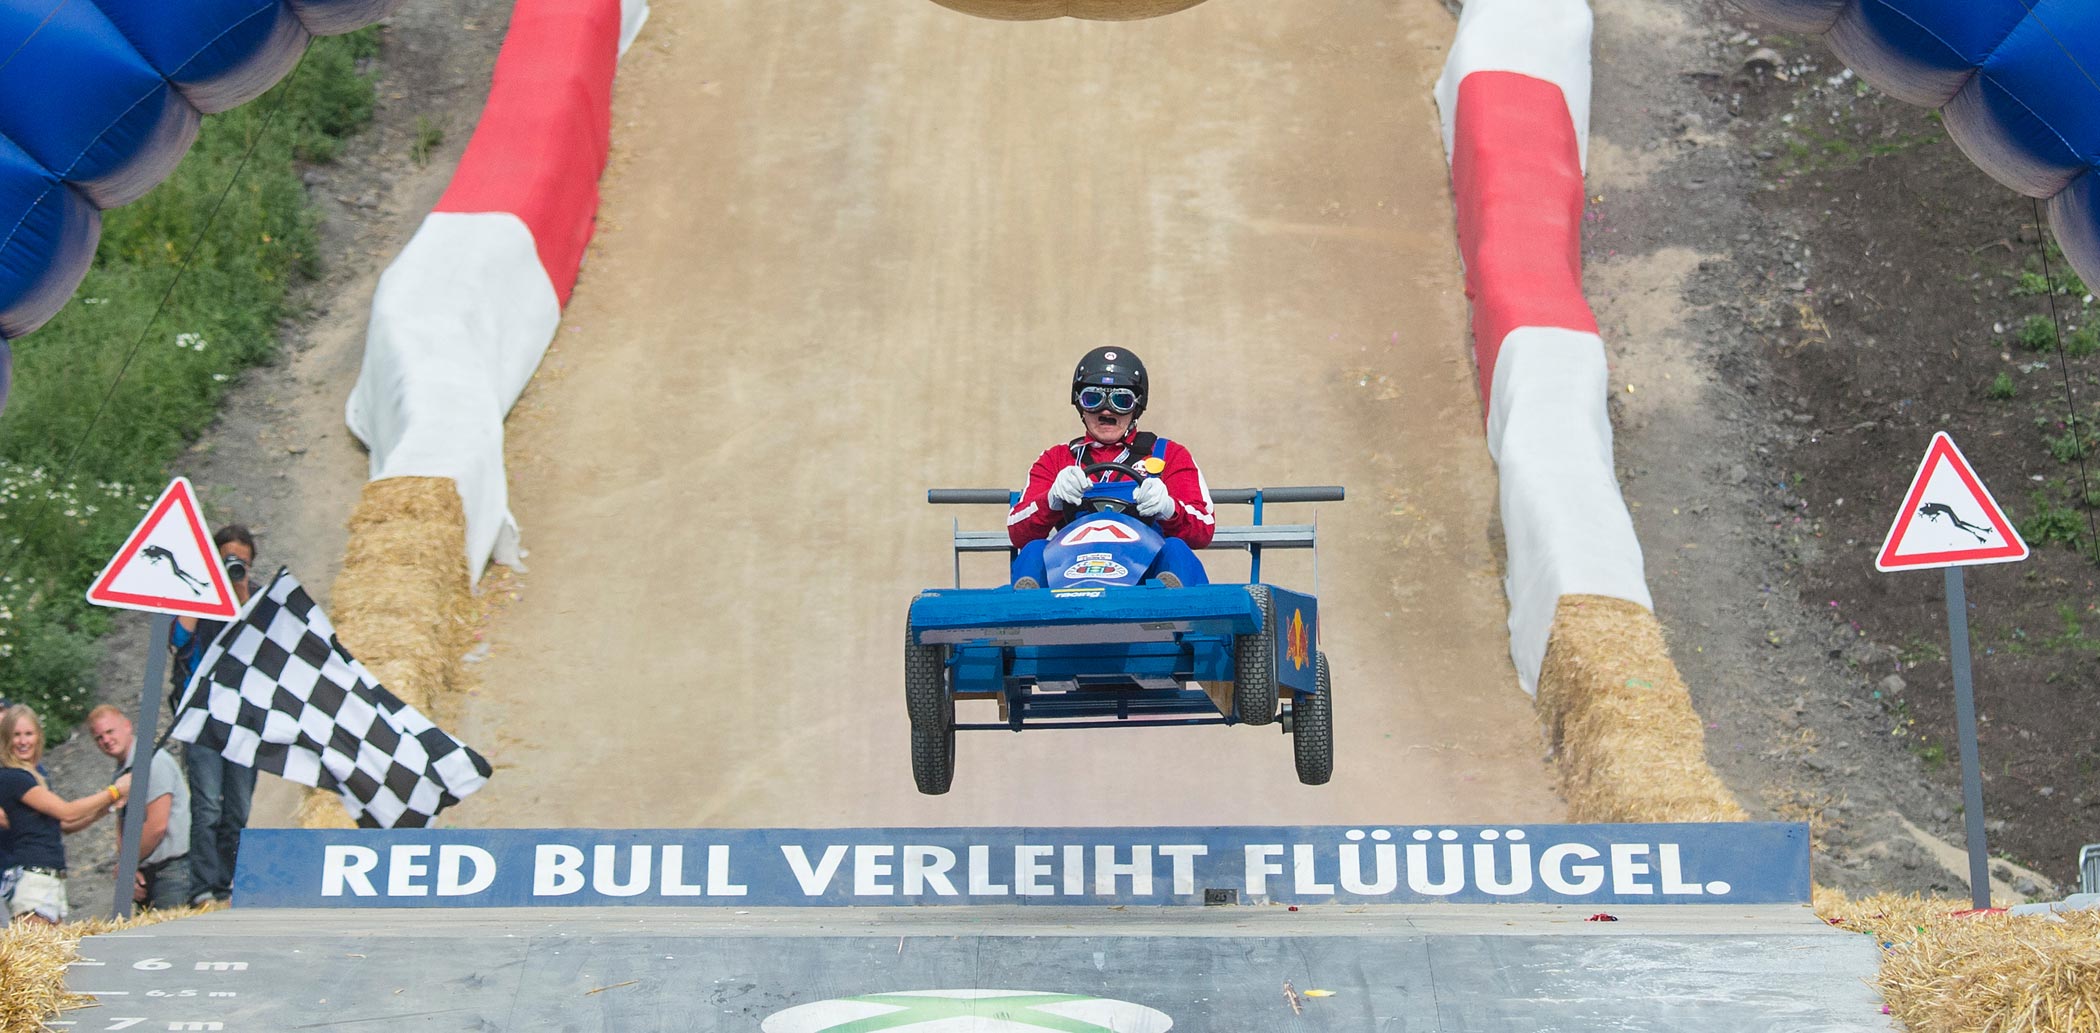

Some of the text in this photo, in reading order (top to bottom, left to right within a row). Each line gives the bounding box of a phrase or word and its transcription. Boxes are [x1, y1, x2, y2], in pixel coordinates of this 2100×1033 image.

[1070, 525, 1131, 542] M
[321, 828, 1732, 897] RED BULL VERLEIHT FLÜÜÜGEL.
[132, 957, 249, 971] 6 m
[145, 989, 197, 998] 6,5
[103, 1017, 224, 1031] 7 m
